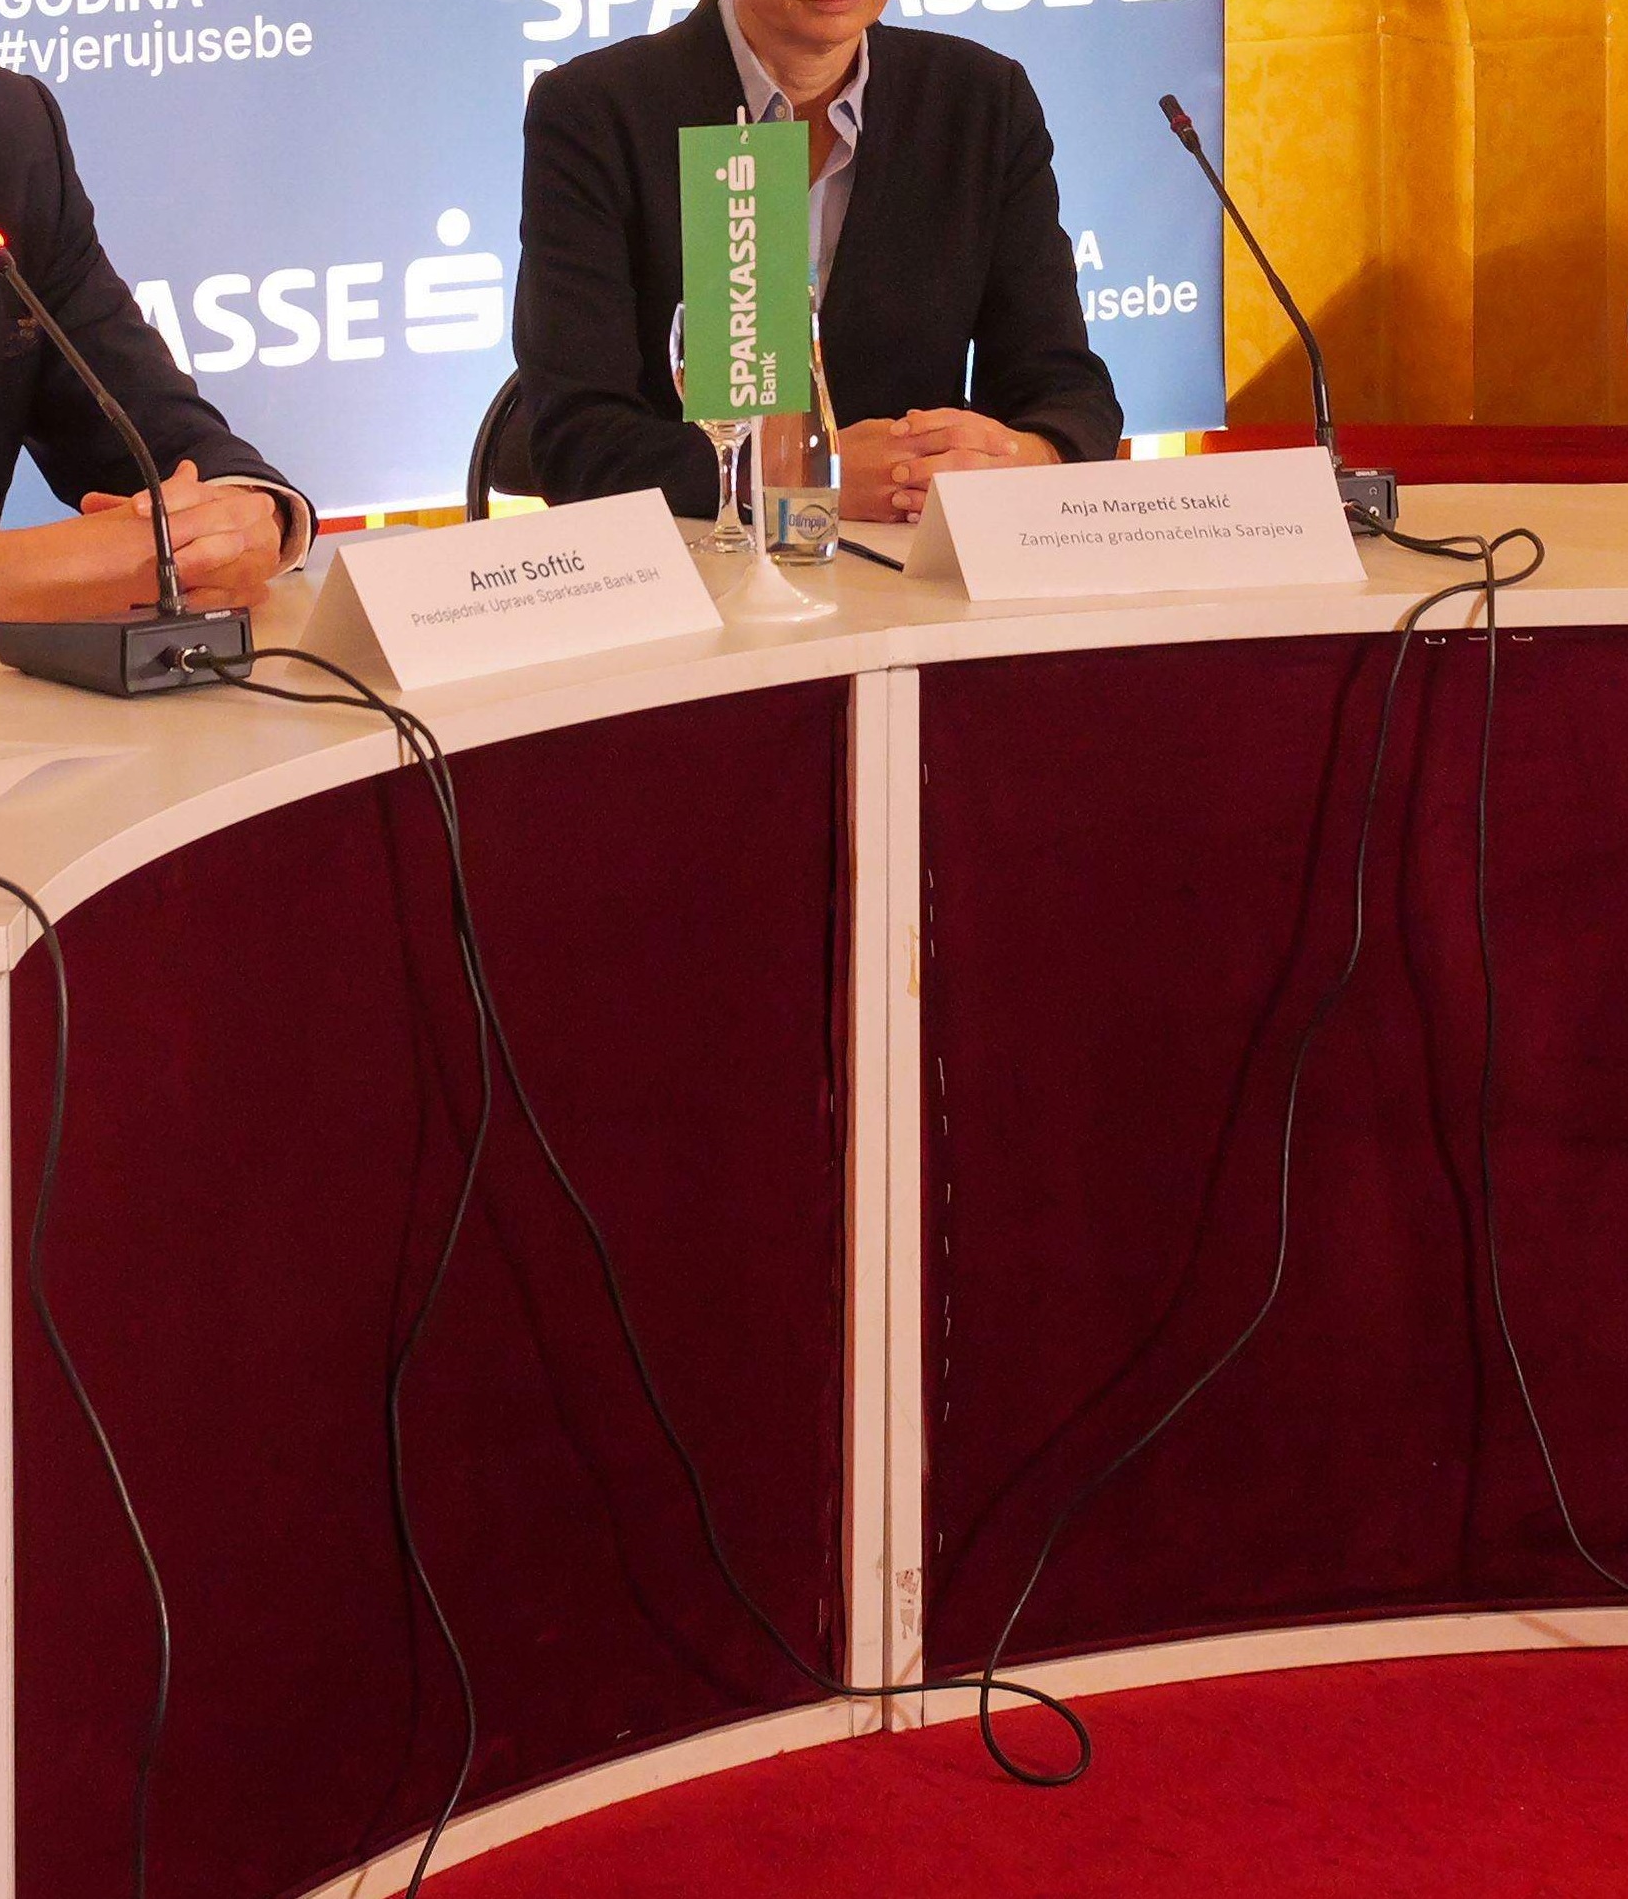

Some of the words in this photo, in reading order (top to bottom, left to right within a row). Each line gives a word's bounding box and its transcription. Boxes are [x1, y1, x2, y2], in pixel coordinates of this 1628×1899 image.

[728, 195, 757, 408] SPARKASSE
[759, 351, 777, 406] Bank
[1060, 501, 1098, 517] Anja
[1103, 496, 1177, 515] Margetić
[1180, 493, 1231, 510] Stakić
[1019, 531, 1104, 548] Zamjenica
[1107, 525, 1232, 546] gradonačelnika
[1235, 522, 1304, 539] Sarajeva
[470, 563, 518, 591] Amir
[522, 550, 586, 581] Softić
[411, 601, 488, 628] Predsjednik
[536, 580, 603, 605] Sparkasse
[603, 572, 635, 591] Bank
